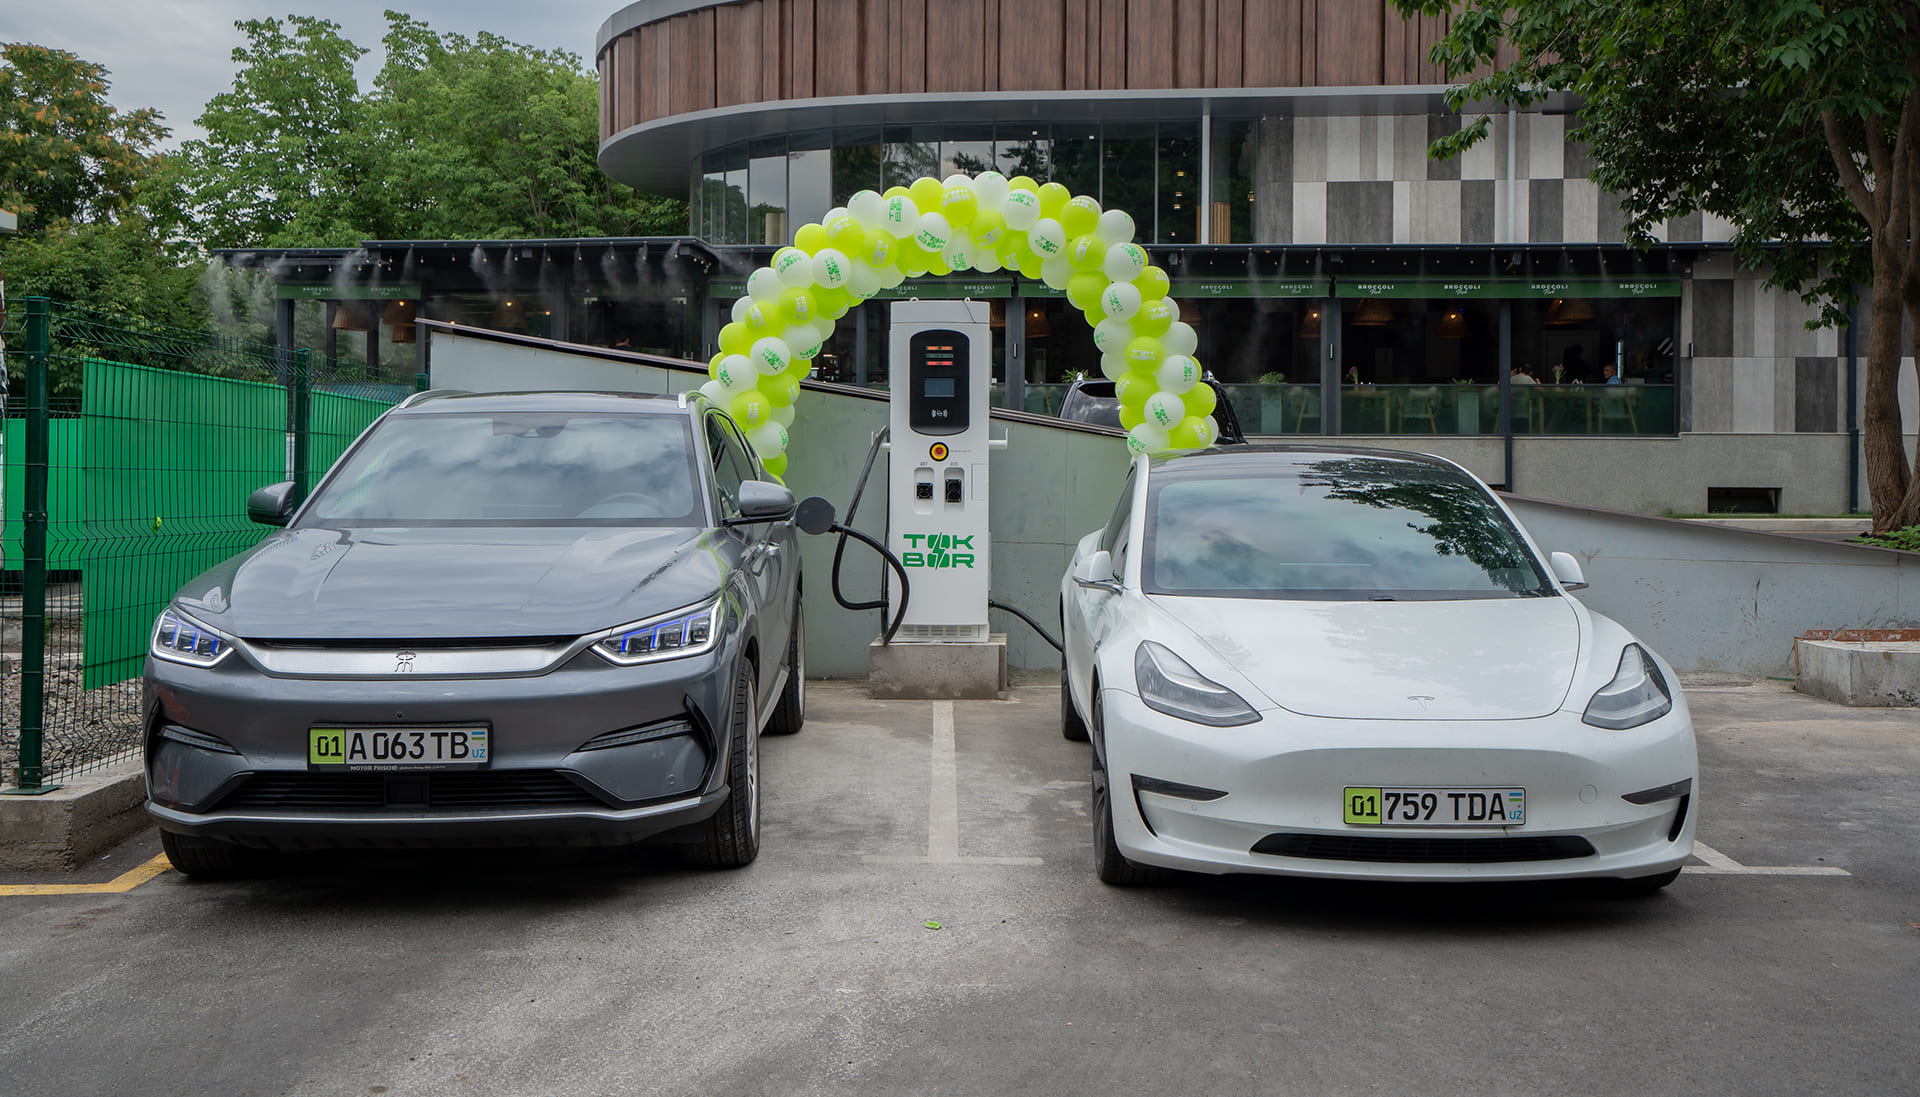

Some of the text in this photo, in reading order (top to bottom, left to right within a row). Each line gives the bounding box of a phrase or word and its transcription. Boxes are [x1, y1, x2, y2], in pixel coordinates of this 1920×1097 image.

[903, 532, 975, 550] TOK
[902, 552, 975, 570] BOR
[317, 736, 342, 757] 01
[471, 749, 486, 759] UZ
[1352, 792, 1524, 821] 01 759 TDA UZ
